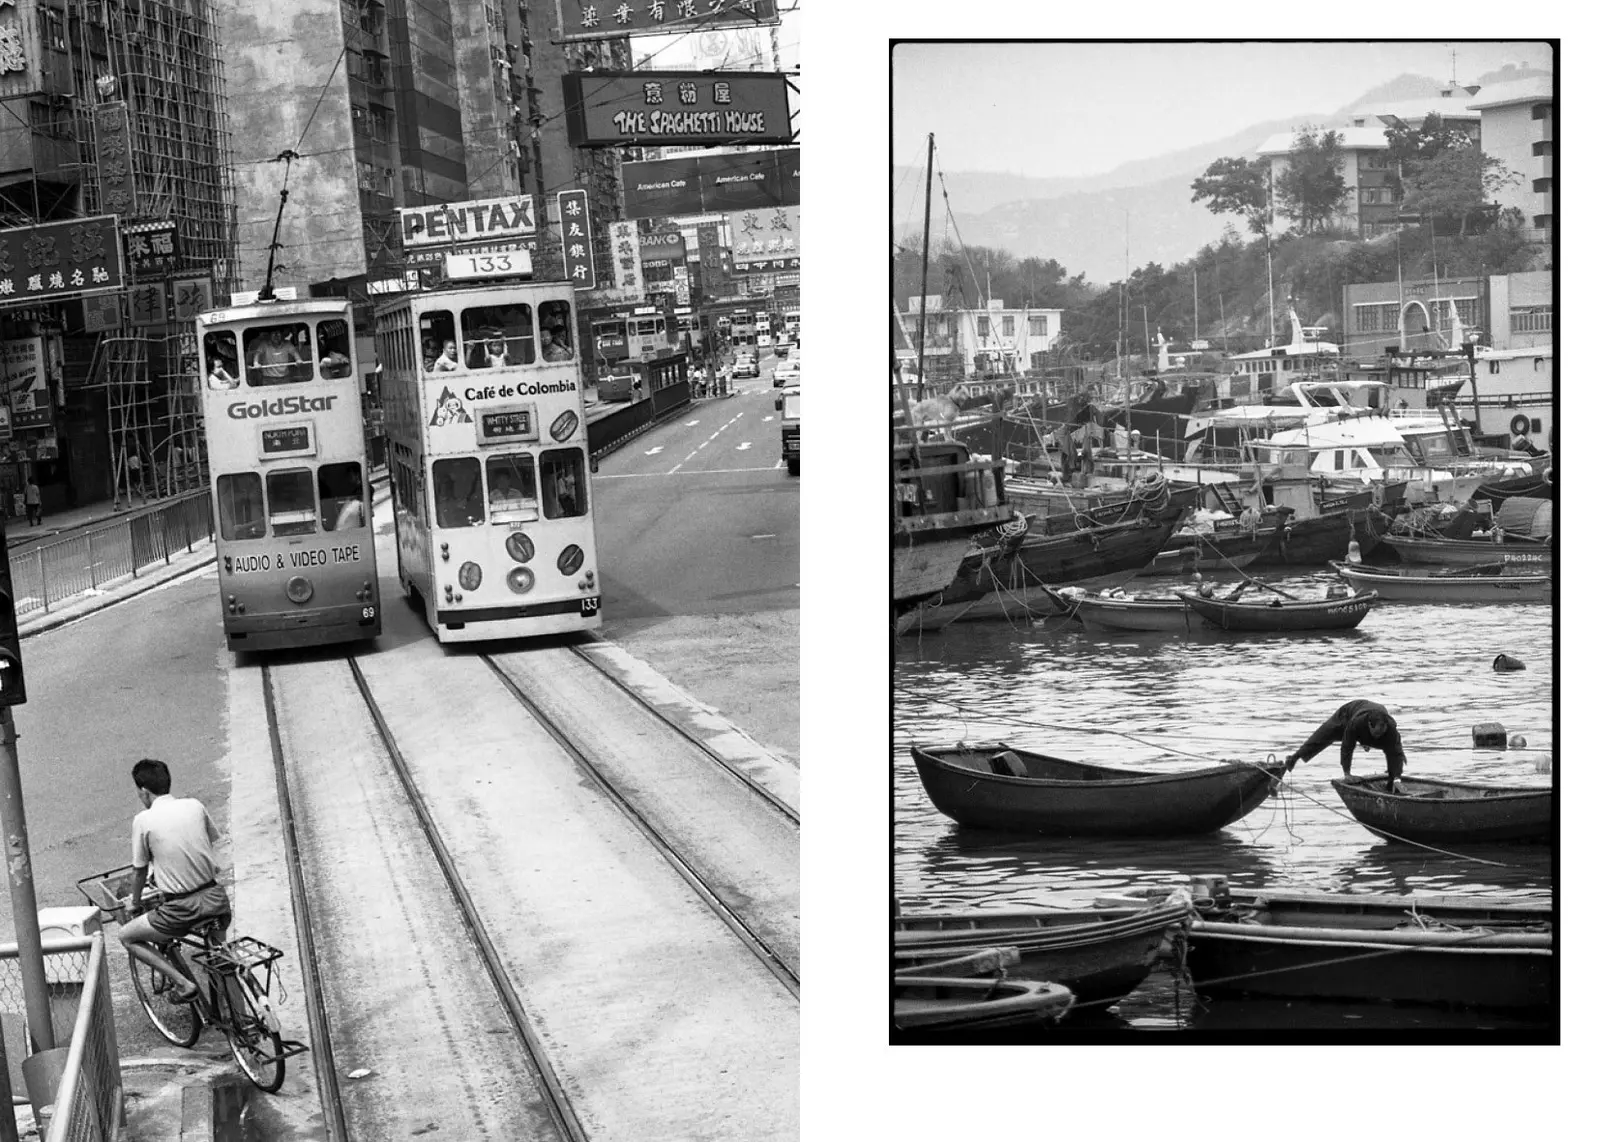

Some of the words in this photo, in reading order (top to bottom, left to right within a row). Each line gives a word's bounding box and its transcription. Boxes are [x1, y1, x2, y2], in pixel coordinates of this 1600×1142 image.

[643, 82, 731, 104] 意粉屋
[613, 111, 647, 133] THE
[725, 111, 765, 133] HOUSE
[637, 181, 670, 191] American
[671, 180, 686, 189] Cafe
[715, 174, 748, 184] American
[749, 172, 765, 182] Cafe
[403, 200, 533, 240] PENTAX
[565, 200, 589, 280] 集友銀行
[640, 235, 667, 247] BANK
[469, 255, 512, 272] 133
[465, 386, 495, 400] Café
[499, 385, 514, 397] de
[517, 379, 576, 396] Colombia
[227, 395, 338, 419] GoldStar
[235, 555, 270, 572] AUDIO
[276, 553, 285, 569] &
[290, 549, 327, 567] VIDEO
[332, 545, 360, 563] TAPE
[362, 607, 375, 618] 69
[581, 598, 598, 611] 133
